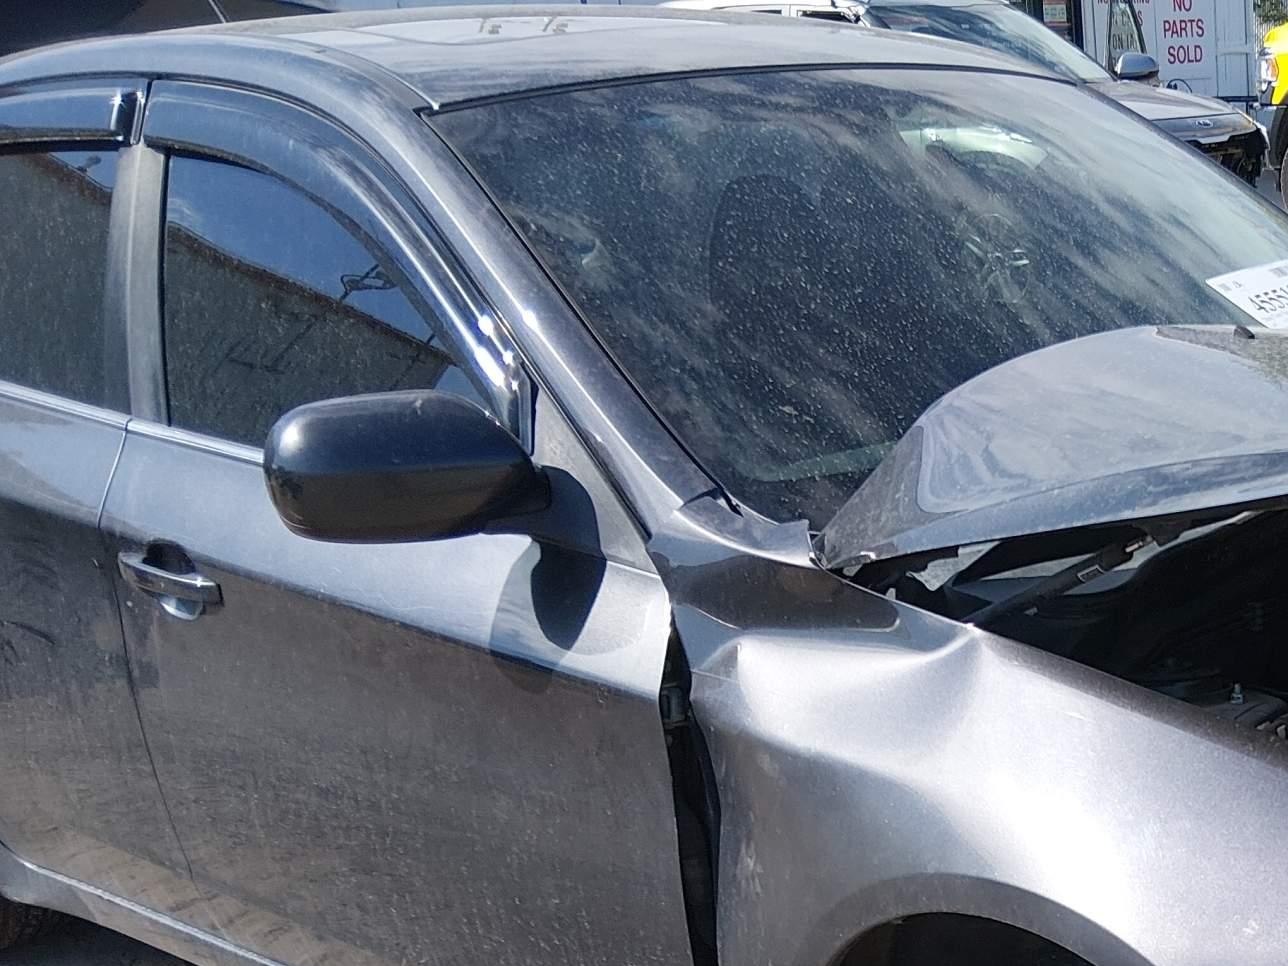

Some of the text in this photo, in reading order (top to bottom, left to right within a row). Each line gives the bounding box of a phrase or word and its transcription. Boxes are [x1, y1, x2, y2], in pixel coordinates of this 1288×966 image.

[1173, 0, 1192, 12] NO
[1163, 19, 1205, 38] PARTS
[1167, 45, 1203, 65] SOLD
